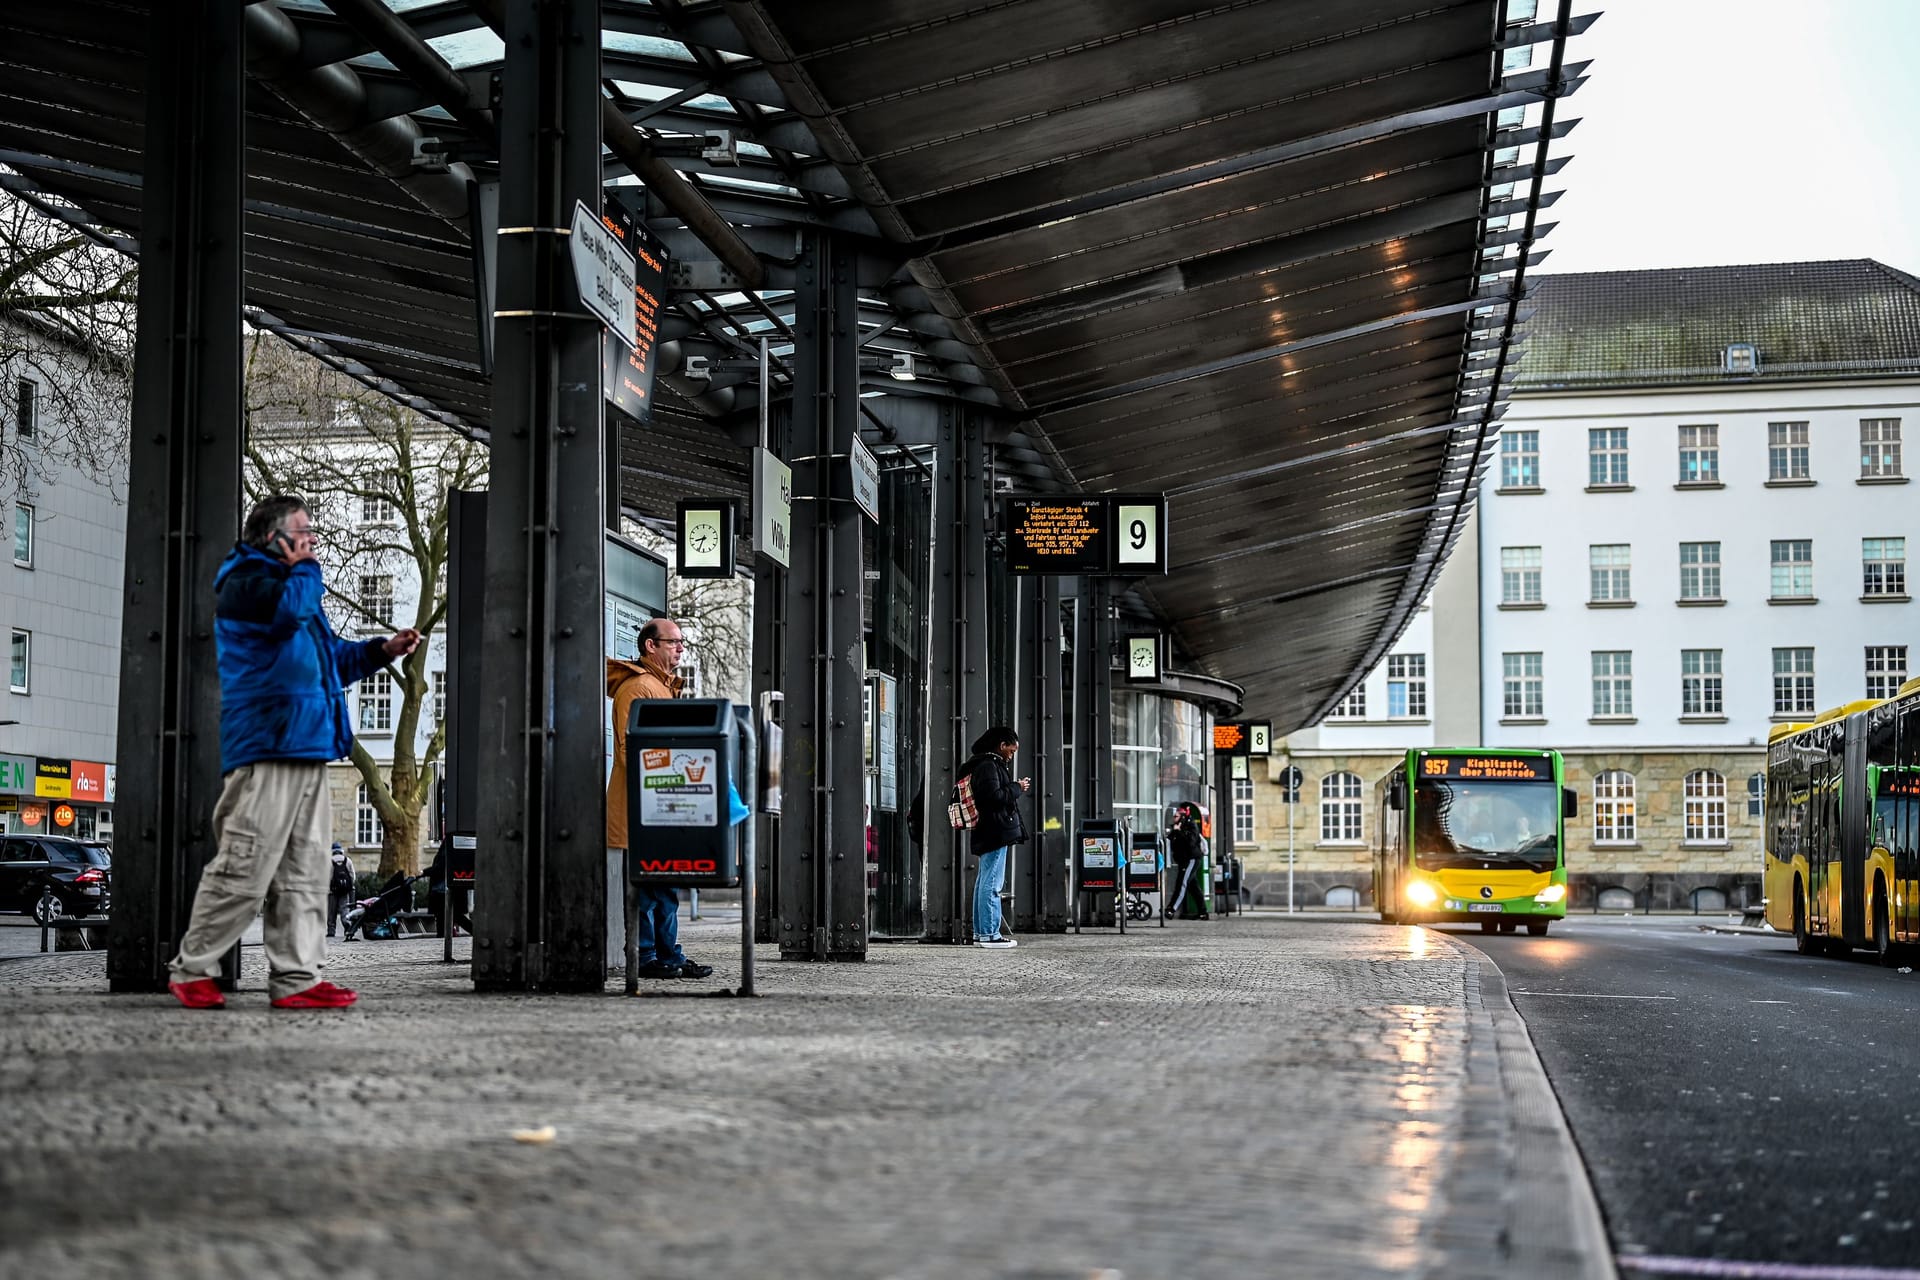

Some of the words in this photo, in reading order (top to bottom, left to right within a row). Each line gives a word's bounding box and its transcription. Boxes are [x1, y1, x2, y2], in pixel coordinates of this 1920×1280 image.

[1131, 520, 1147, 550] 9
[1256, 732, 1264, 745] 8
[645, 752, 668, 760] MACH
[1425, 759, 1449, 775] 957
[77, 772, 89, 791] ria
[56, 808, 71, 819] ria
[640, 859, 716, 871] WBO
